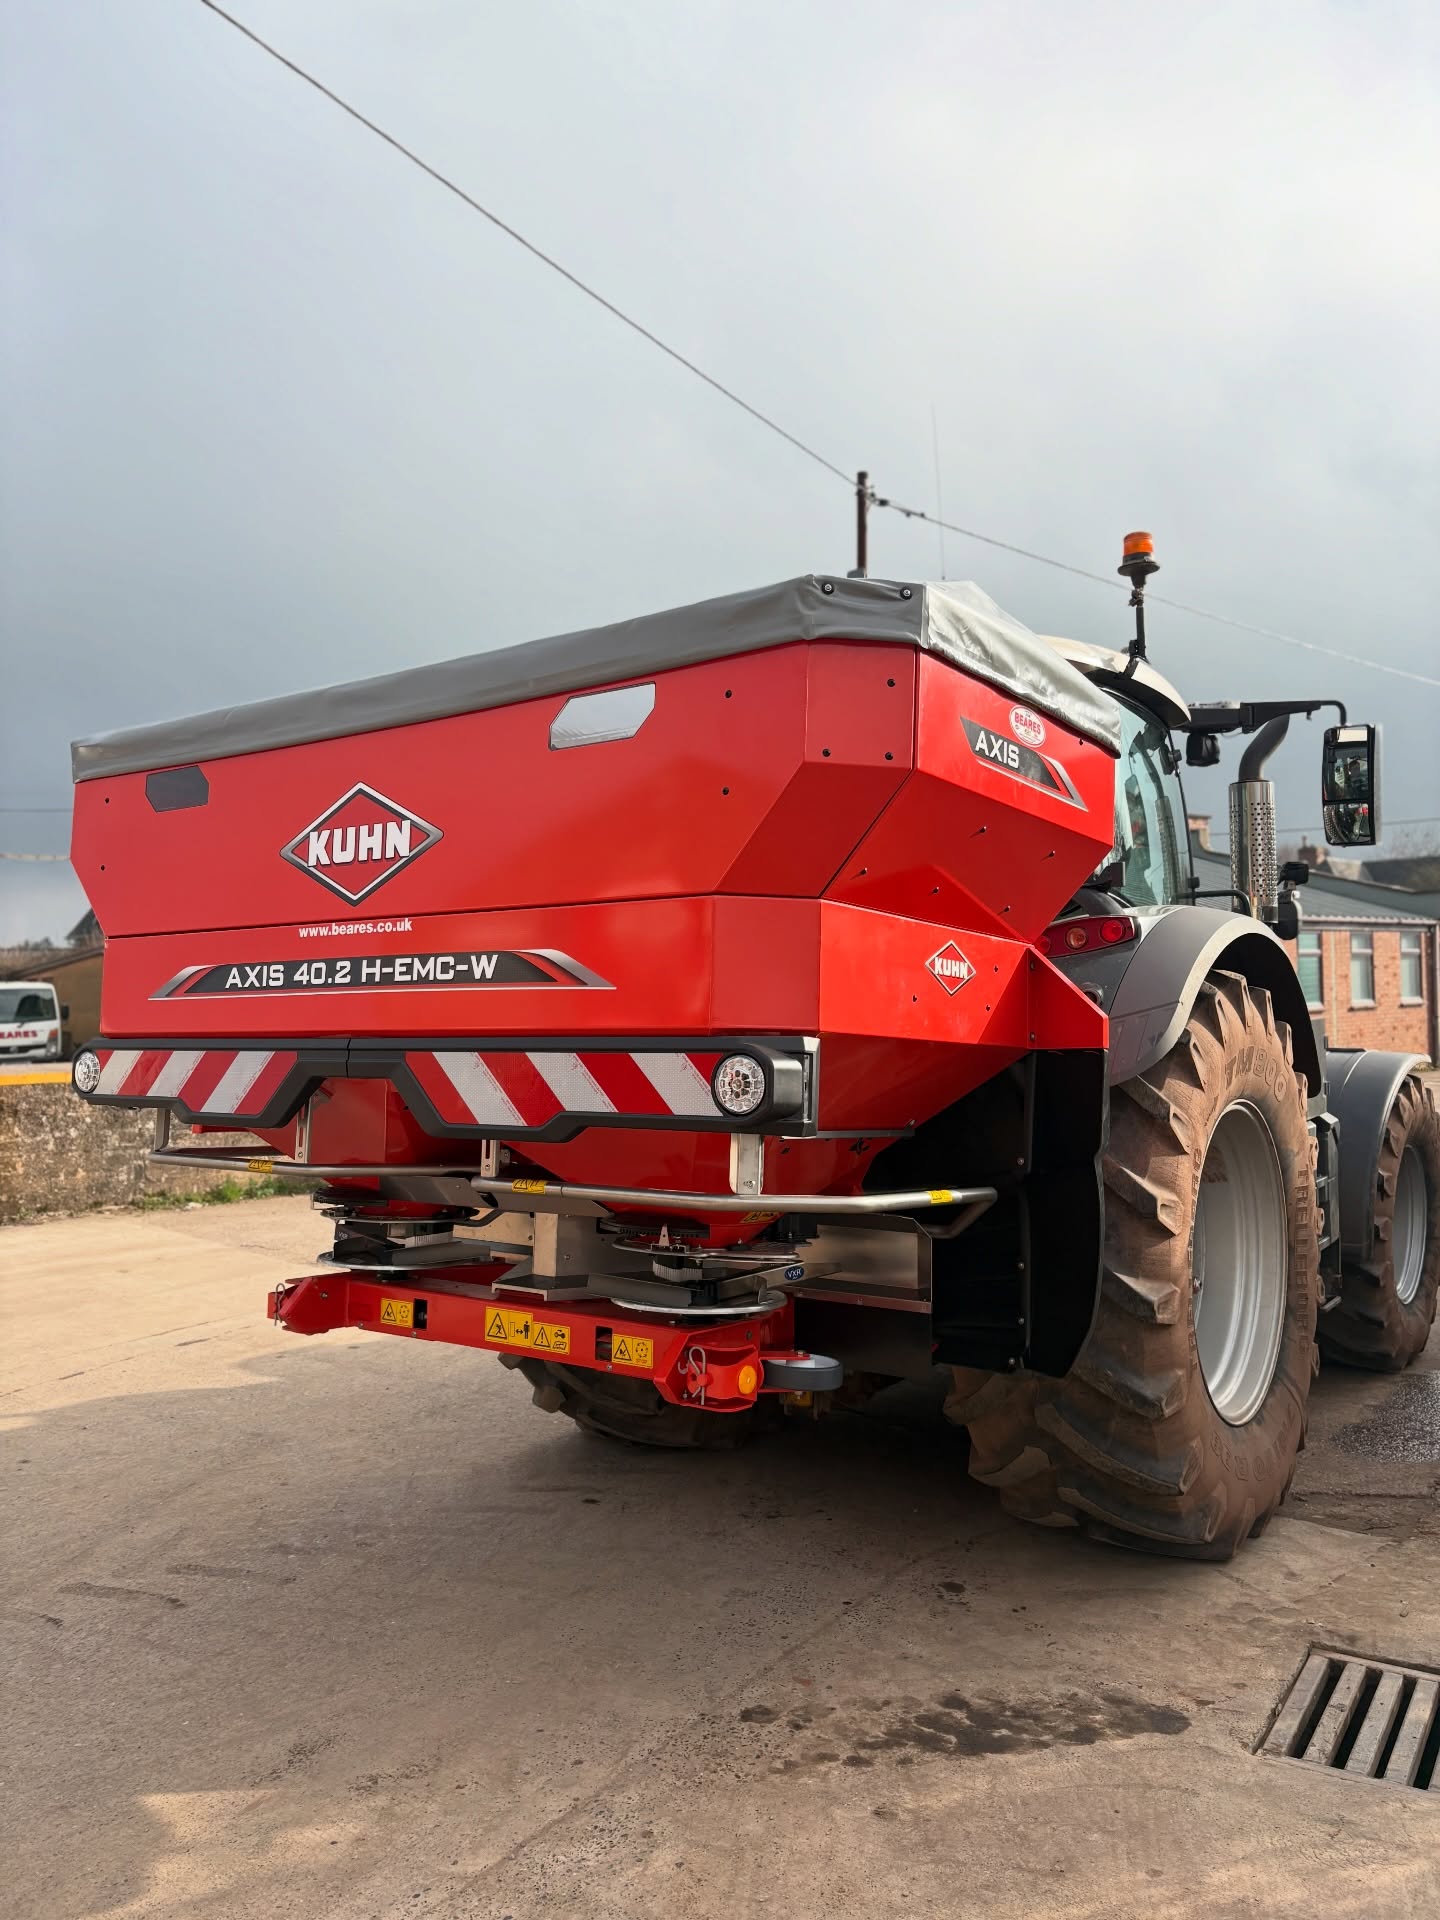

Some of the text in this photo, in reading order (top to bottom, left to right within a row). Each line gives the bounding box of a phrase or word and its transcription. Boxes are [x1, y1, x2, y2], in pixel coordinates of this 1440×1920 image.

[1014, 711, 1041, 735] BEARES
[975, 730, 1020, 769] AXIS
[307, 819, 411, 867] KUHN
[298, 917, 413, 938] www.beares.co.uk
[225, 954, 499, 989] AXIS 40.2 H-EMC-W
[934, 956, 969, 979] KUHN
